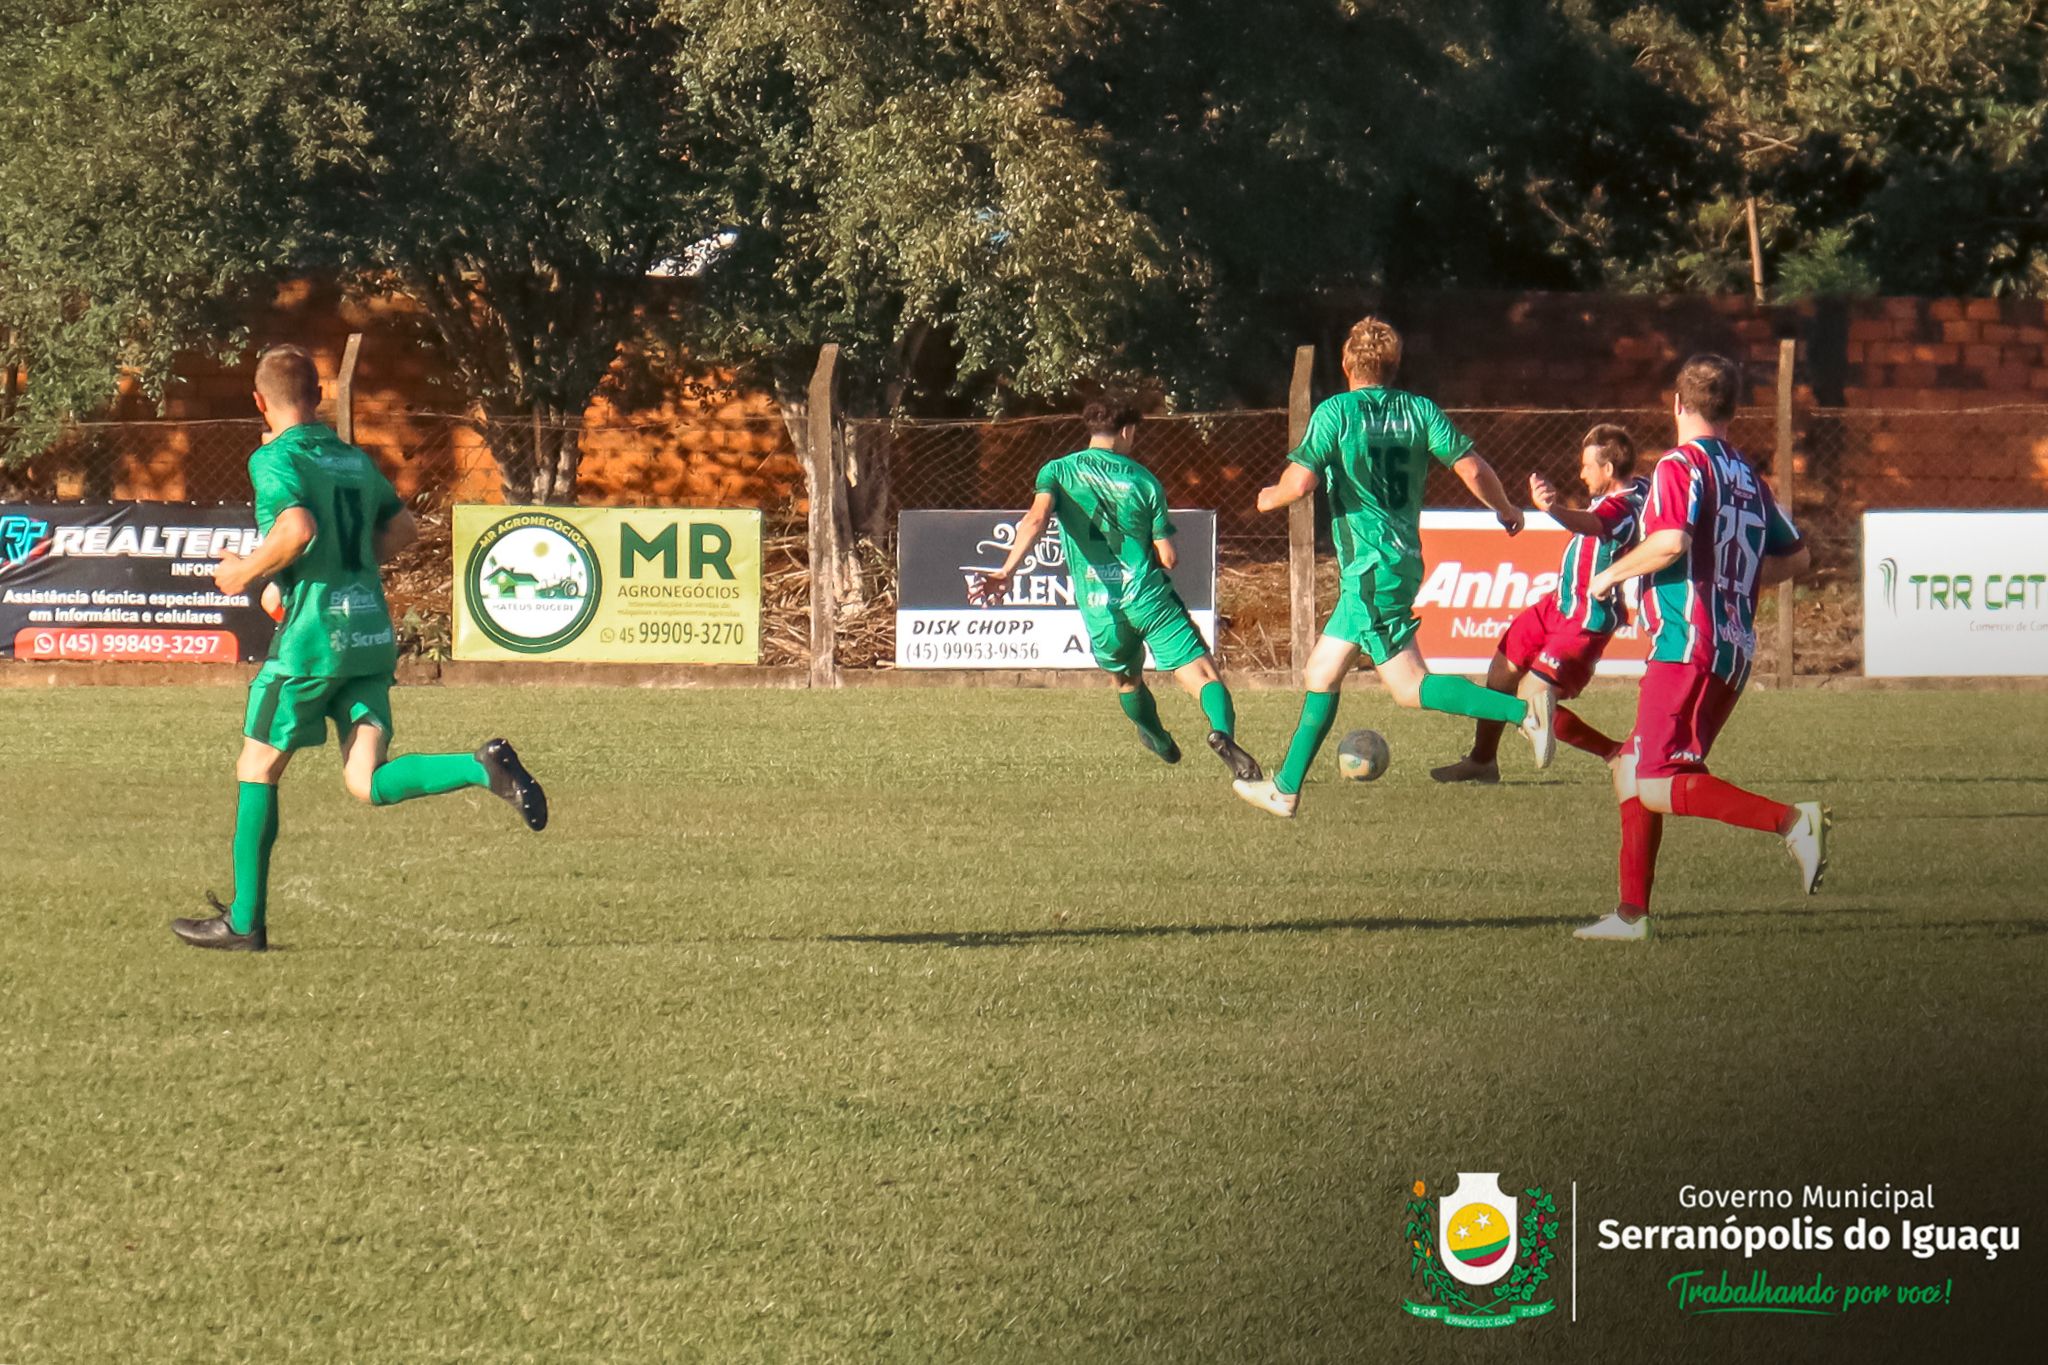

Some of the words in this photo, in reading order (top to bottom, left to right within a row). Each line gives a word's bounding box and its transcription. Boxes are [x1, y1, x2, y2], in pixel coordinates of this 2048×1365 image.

[479, 530, 497, 547] MR
[619, 521, 737, 580] MR
[171, 562, 219, 577] INFOR
[617, 583, 741, 599] AGRONEGÓCIOS
[1411, 561, 1559, 608] Anha
[1908, 574, 1973, 610] TRR
[2, 589, 90, 605] Assistência
[92, 589, 147, 606] técnica
[149, 591, 249, 609] especializada
[29, 609, 52, 622] em
[55, 607, 139, 623] informática
[142, 610, 152, 623] e
[154, 608, 224, 625] celulares
[619, 627, 635, 644] 45
[639, 622, 745, 645] 99909-3270
[912, 620, 961, 636] DISK
[967, 620, 1034, 636] CHOPP
[59, 632, 98, 656] (45)
[102, 633, 220, 654] 99849-3297
[906, 642, 939, 663] (45)
[942, 642, 1040, 660] 99953-9856
